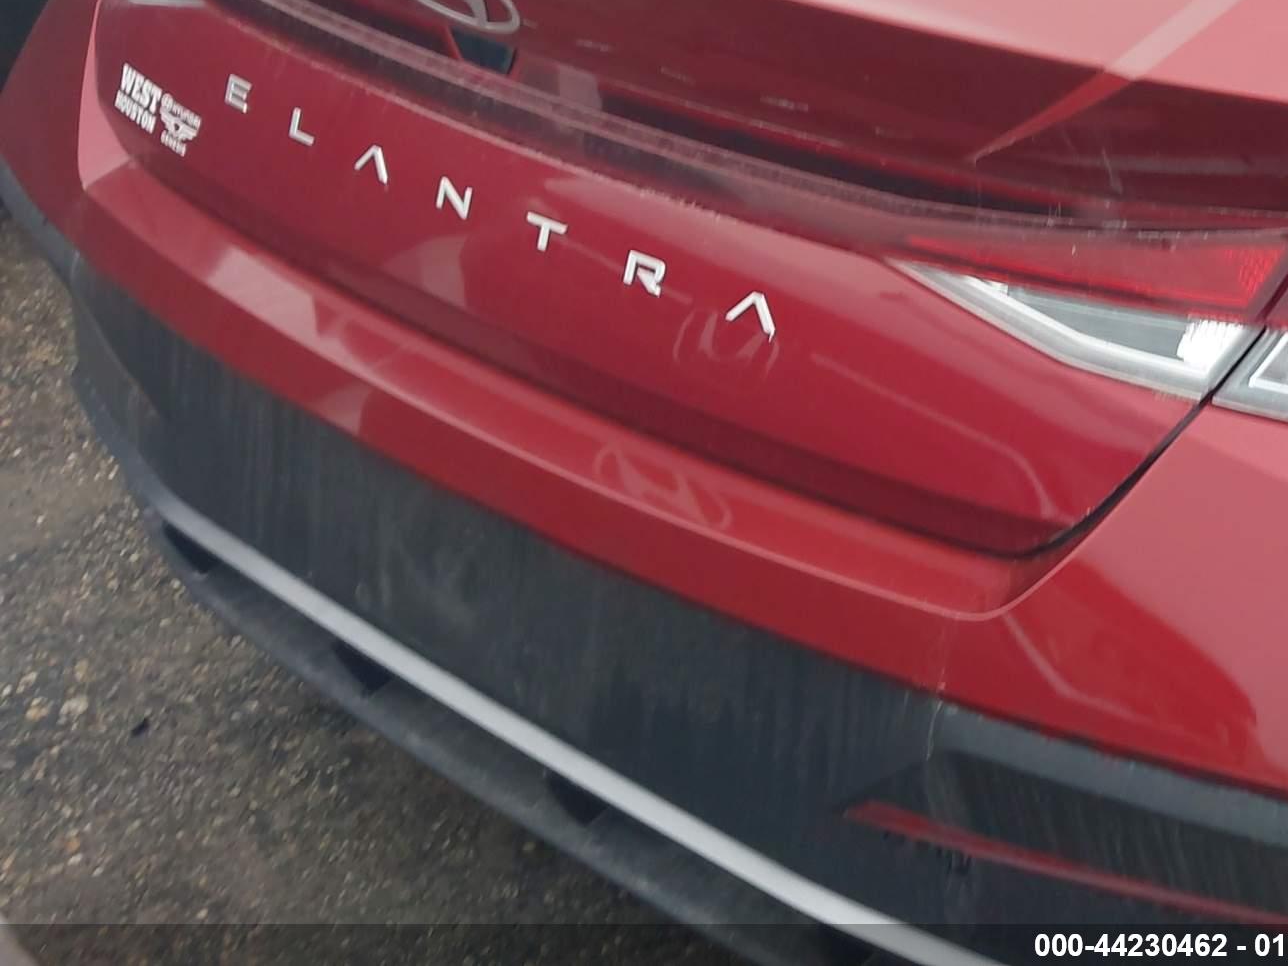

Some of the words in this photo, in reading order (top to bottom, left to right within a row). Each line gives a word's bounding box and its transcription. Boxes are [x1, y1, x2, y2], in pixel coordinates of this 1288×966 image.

[114, 89, 157, 134] HOUSTON
[121, 62, 163, 114] WEST
[224, 73, 776, 338] ELANTRA
